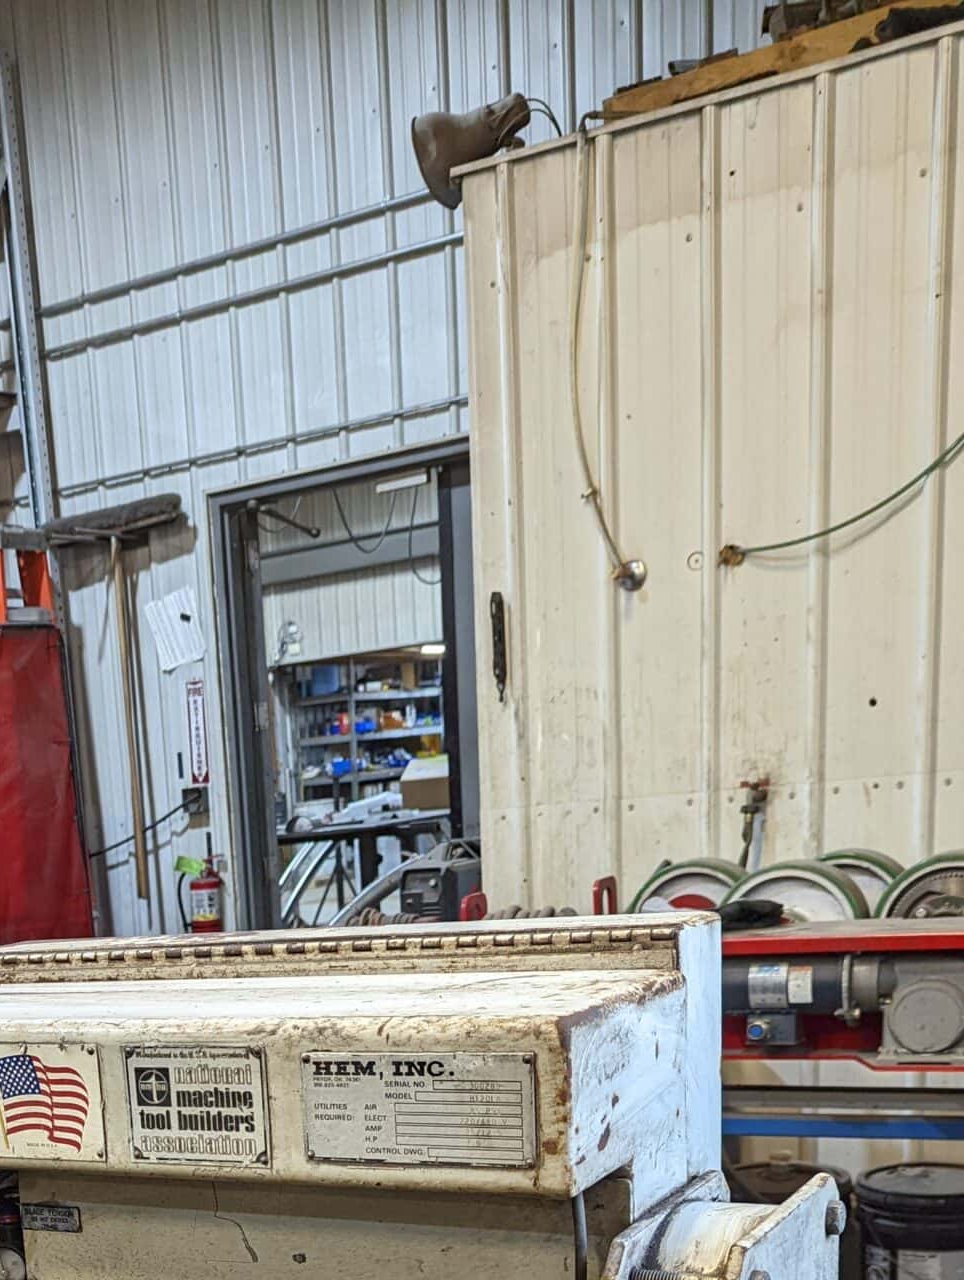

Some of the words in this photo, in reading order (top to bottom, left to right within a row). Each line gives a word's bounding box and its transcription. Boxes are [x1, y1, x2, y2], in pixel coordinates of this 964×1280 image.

[188, 688, 204, 696] FIRE
[174, 1064, 253, 1085] national
[312, 1061, 384, 1080] HEM,
[392, 1060, 455, 1077] INC.
[384, 1080, 412, 1088] SERIAL
[176, 1087, 254, 1109] machine
[384, 1092, 413, 1100] MODEL
[314, 1103, 348, 1111] UTILITIES
[139, 1109, 172, 1130] tool
[140, 1133, 257, 1156] association
[365, 1146, 402, 1155] CONTROL
